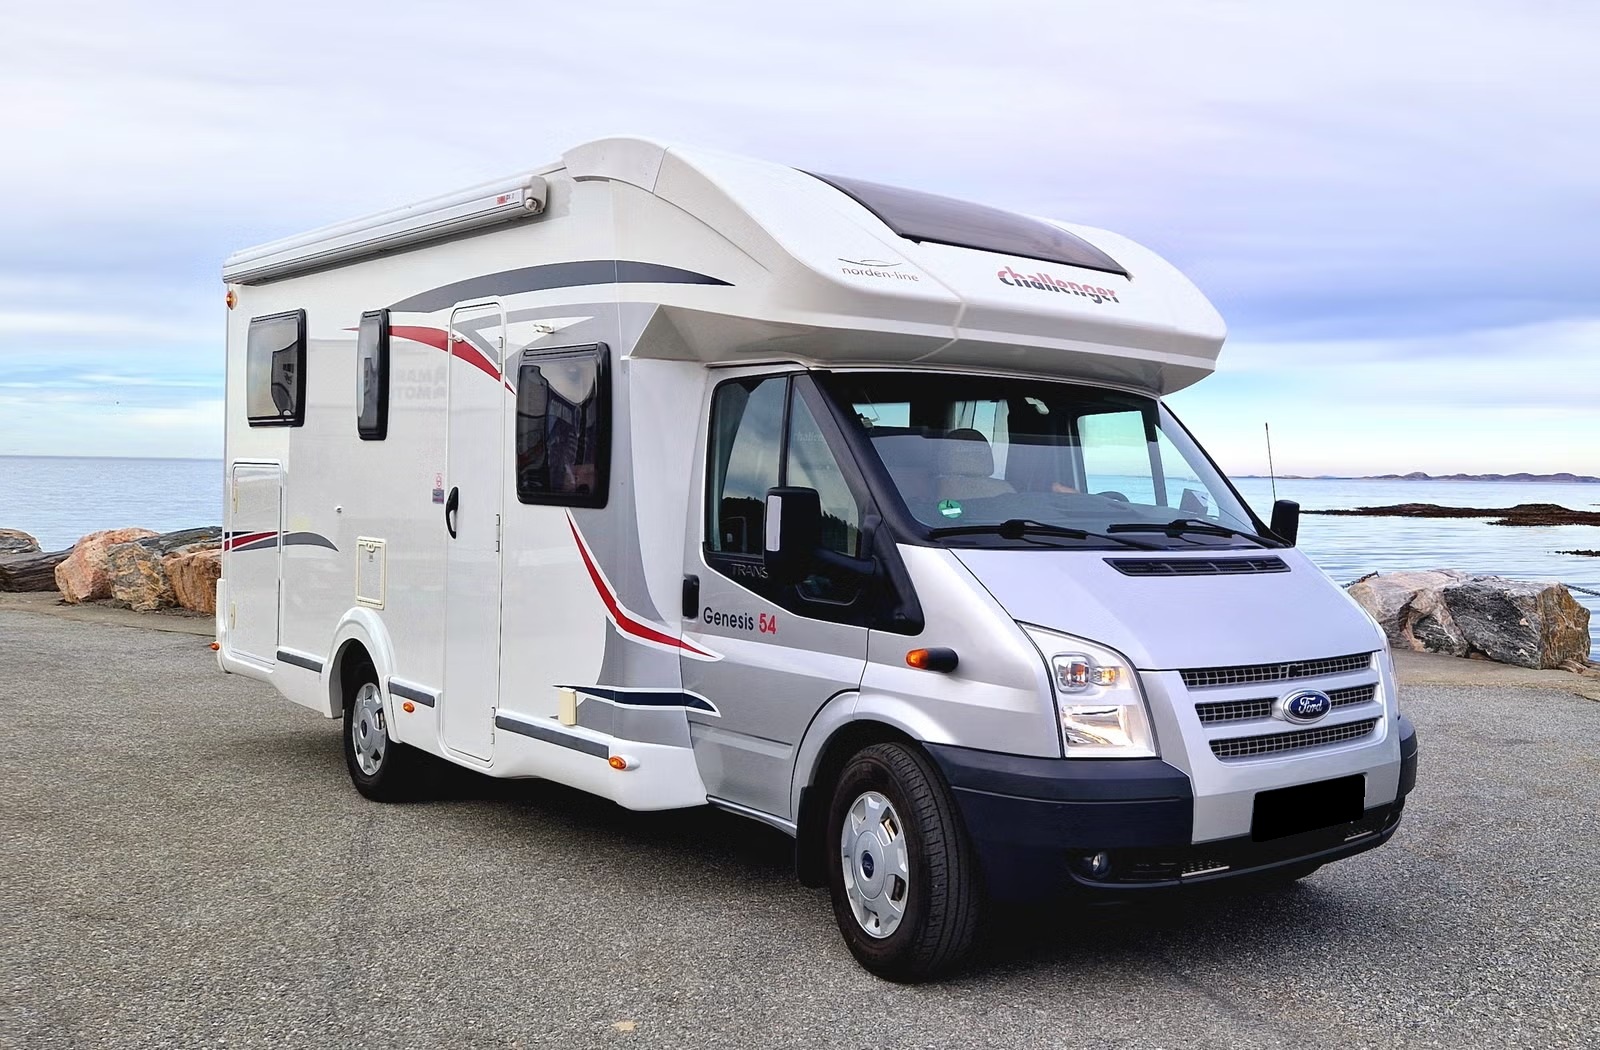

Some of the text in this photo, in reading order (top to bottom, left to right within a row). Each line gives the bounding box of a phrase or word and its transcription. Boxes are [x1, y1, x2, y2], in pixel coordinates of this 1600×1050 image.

[842, 267, 919, 282] norden-line
[997, 265, 1120, 304] challenger
[730, 563, 769, 579] TRANS
[703, 606, 777, 634] Genesis 54
[1298, 696, 1323, 714] Ford
